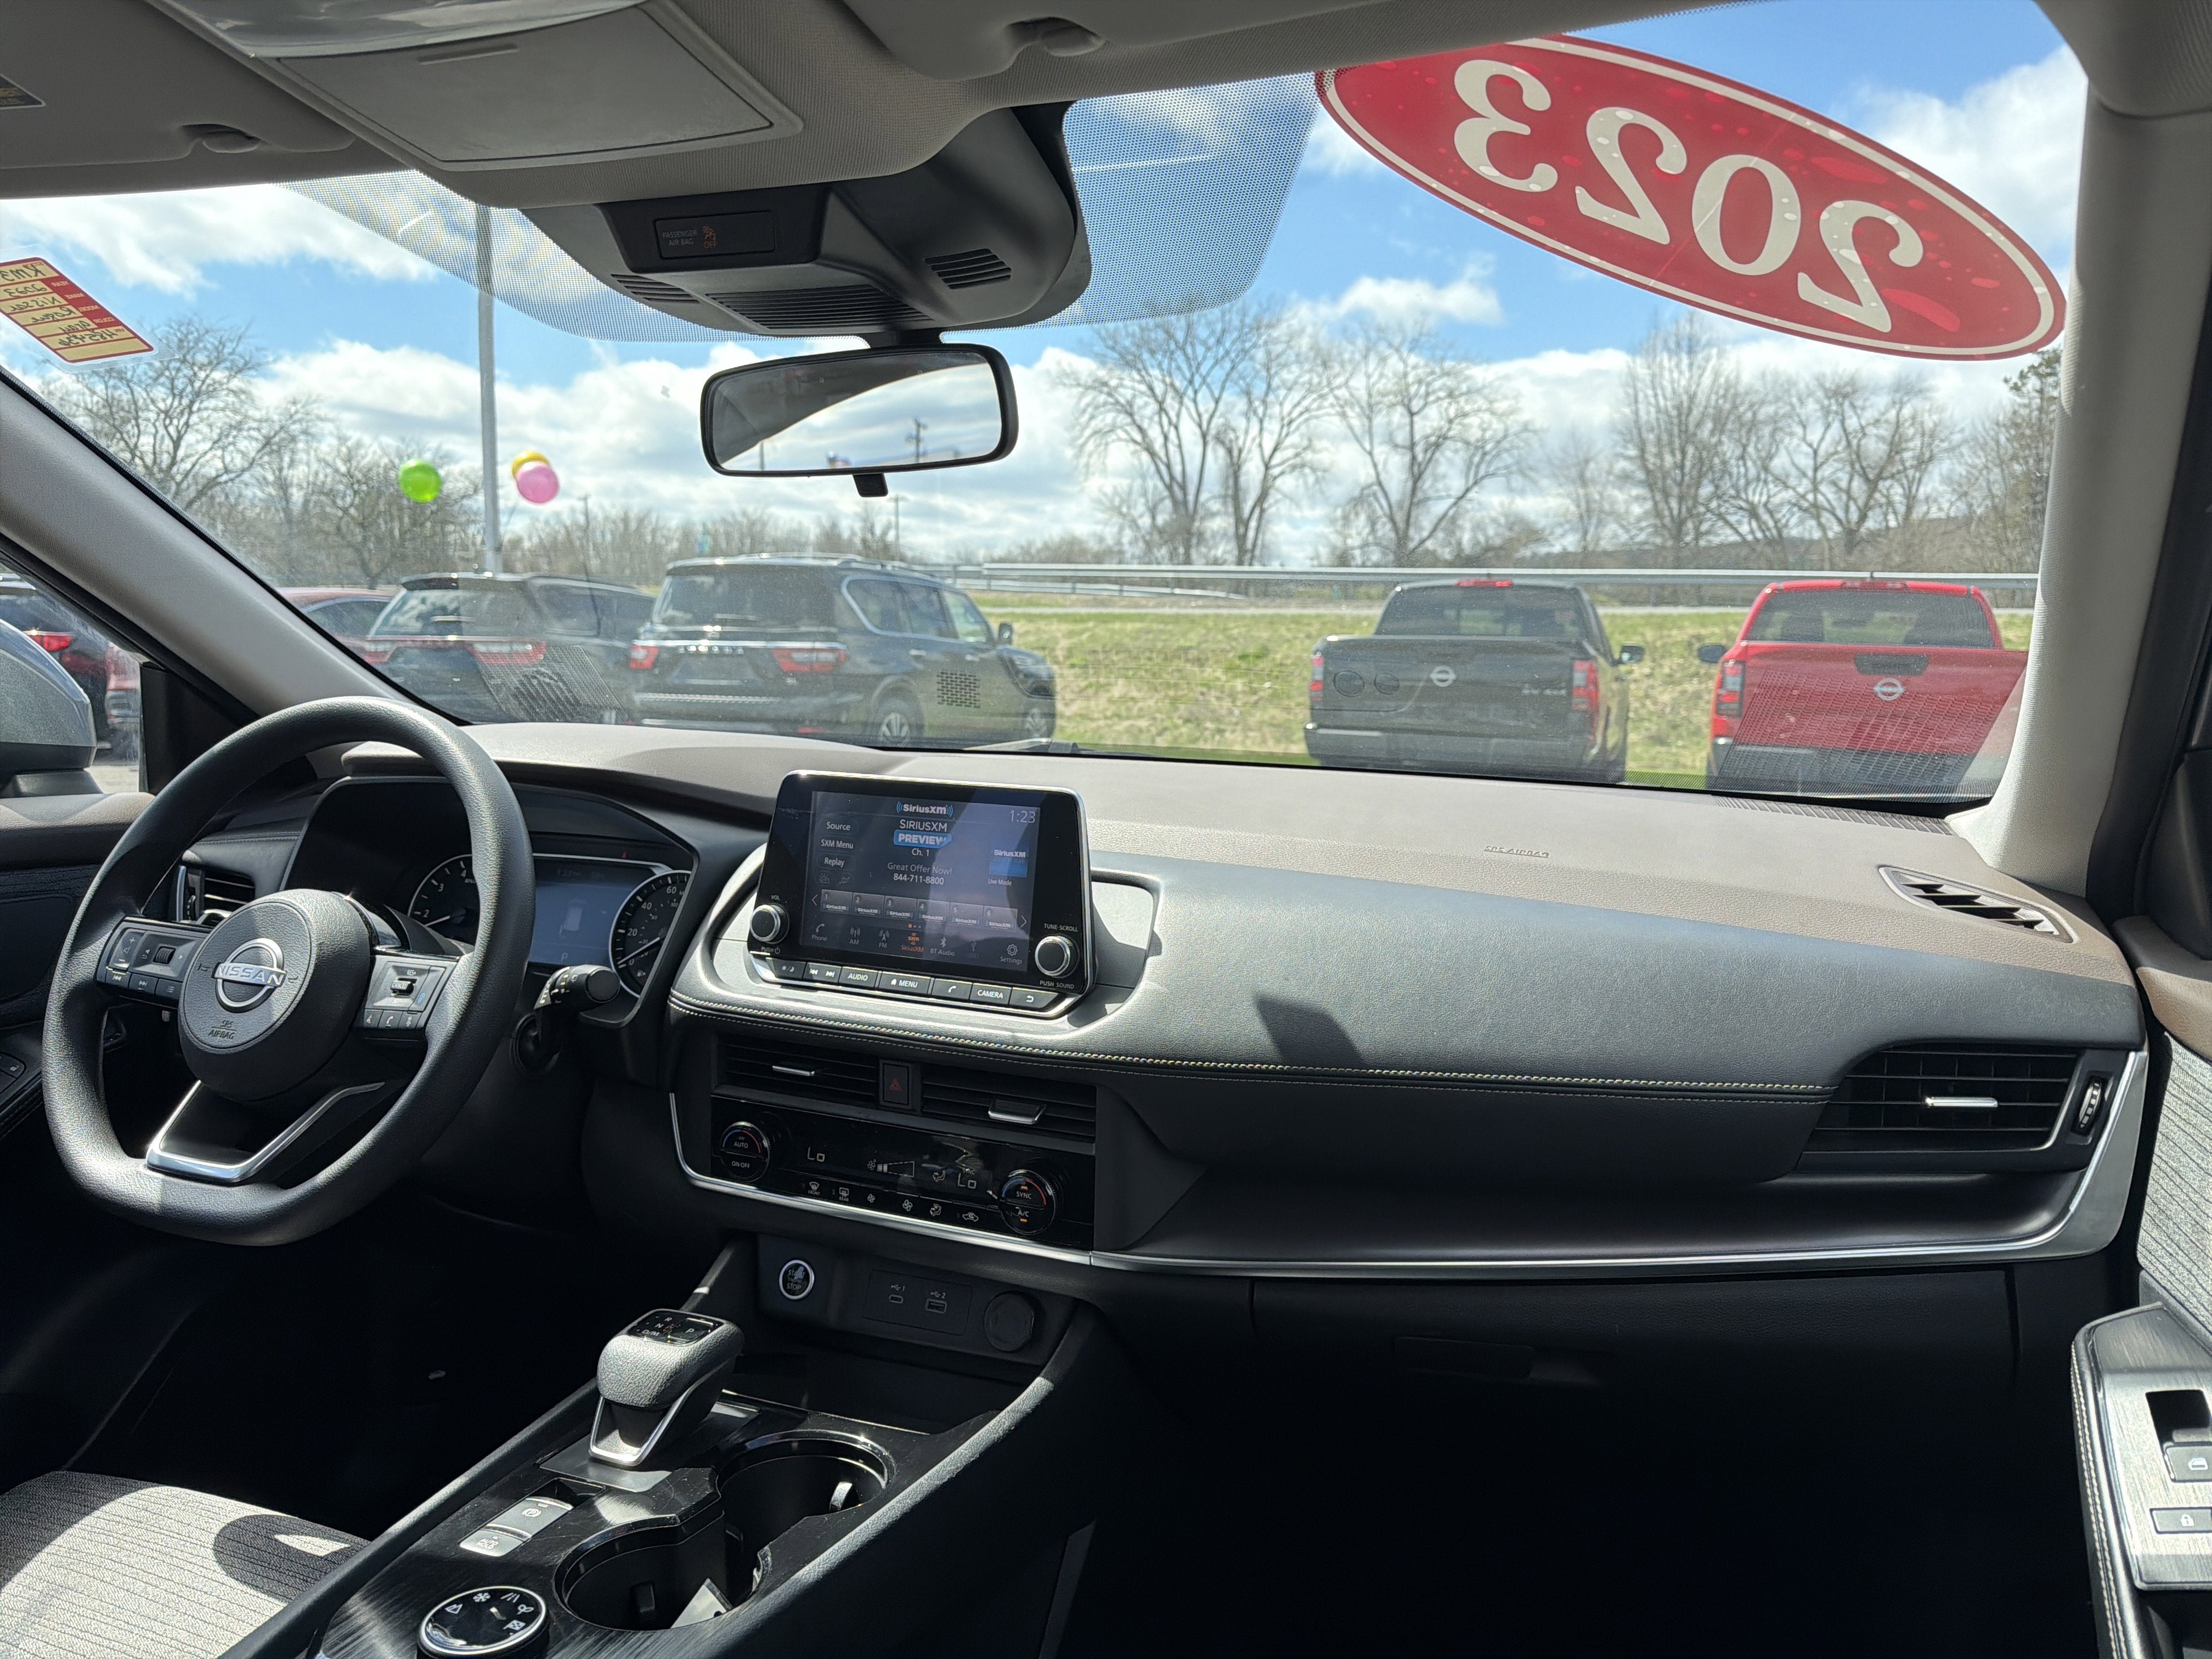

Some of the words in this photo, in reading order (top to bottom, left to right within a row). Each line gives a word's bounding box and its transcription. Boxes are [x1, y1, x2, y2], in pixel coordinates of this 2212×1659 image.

[662, 229, 698, 239] PASSENGER
[668, 239, 680, 247] AIR
[681, 237, 694, 246] BAG
[703, 241, 718, 250] OFF
[1010, 810, 1036, 823] 1:23
[826, 821, 850, 831] Source
[899, 819, 947, 832] SIRIUSXM
[821, 839, 835, 848] SXM
[836, 840, 854, 849] Menu
[898, 833, 947, 845] PREVIEW
[911, 848, 923, 857] Ch.
[926, 849, 930, 857] 1
[824, 857, 845, 868] Replay
[461, 869, 467, 877] 4
[887, 862, 909, 872] Great
[910, 864, 930, 873] Offer
[933, 865, 952, 875] Now!
[893, 873, 945, 885] 844-711-8800
[438, 883, 444, 891] 3
[666, 886, 677, 894] 60
[641, 902, 652, 910] 40
[423, 910, 430, 918] 2
[627, 928, 638, 936] 20
[901, 944, 924, 953] SiriusXM
[561, 952, 568, 962] P
[1000, 956, 1023, 965] Settings
[218, 963, 283, 986] NISSAN
[899, 979, 918, 989] MENU
[977, 989, 1003, 999] CAMERA
[207, 1029, 236, 1040] AIRBAG
[1016, 1191, 1032, 1199] SYNC
[786, 1282, 802, 1291] STOP
[476, 1542, 495, 1550] HOLD
[479, 1538, 499, 1547] AUTO
